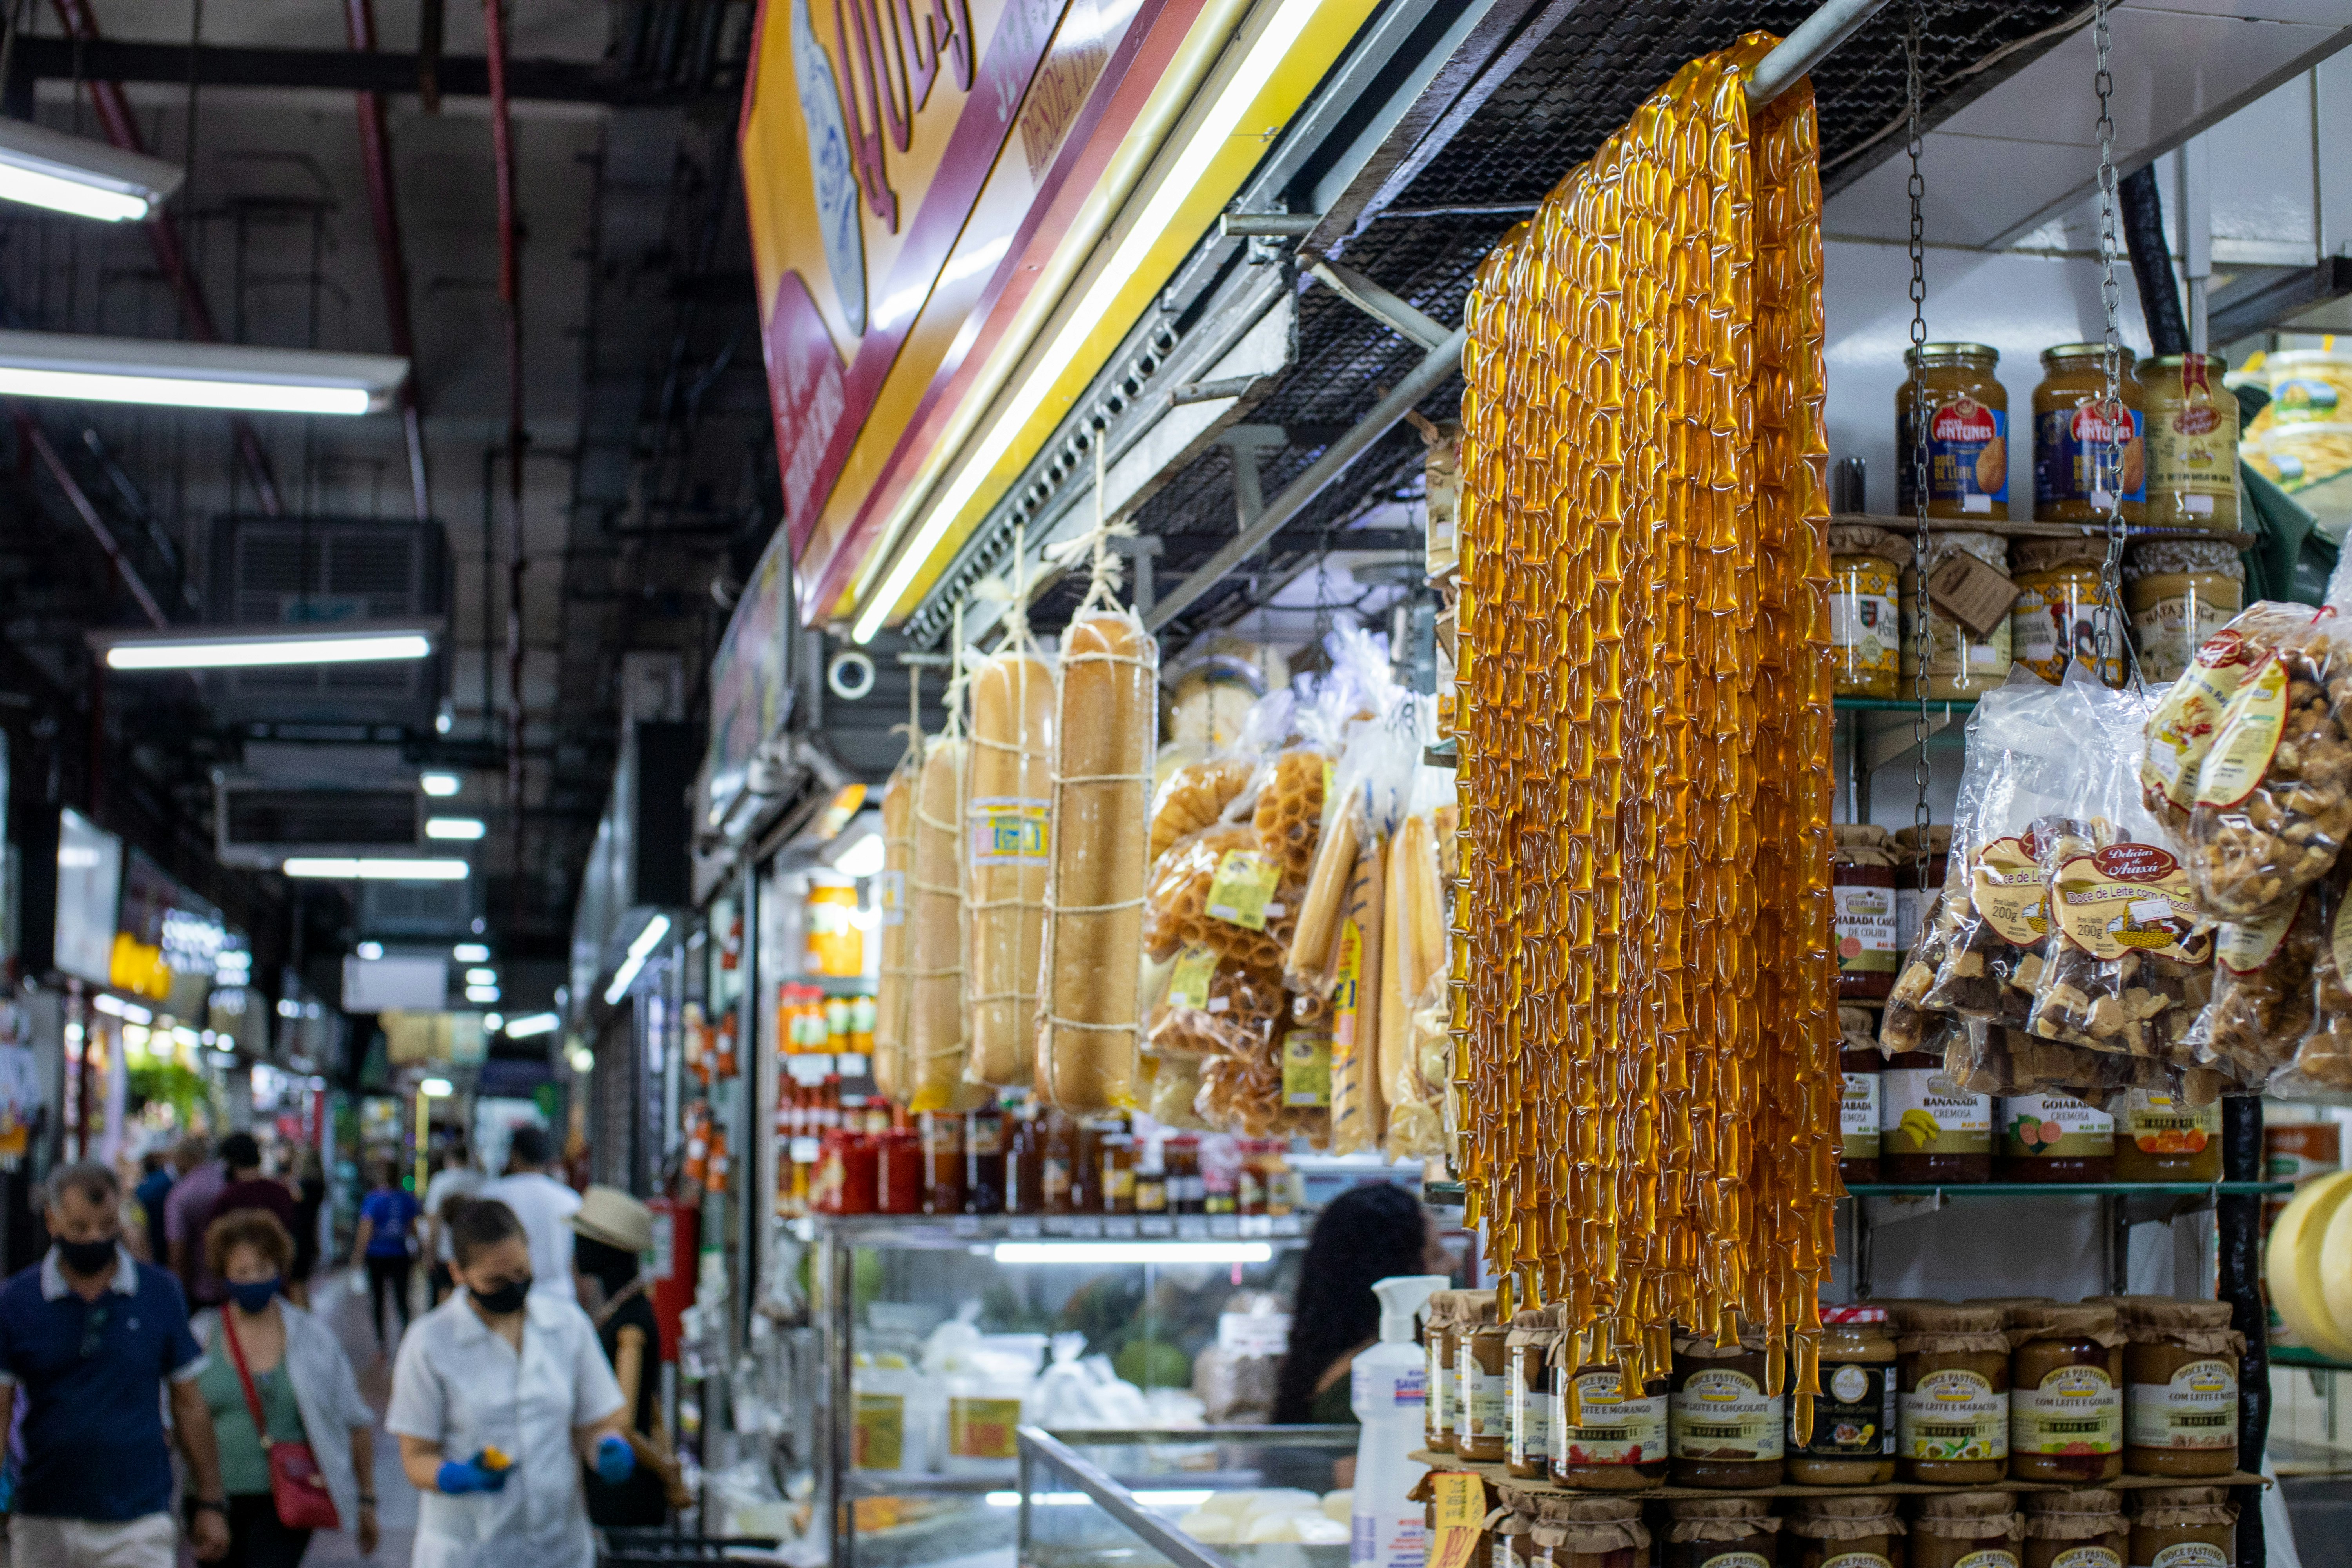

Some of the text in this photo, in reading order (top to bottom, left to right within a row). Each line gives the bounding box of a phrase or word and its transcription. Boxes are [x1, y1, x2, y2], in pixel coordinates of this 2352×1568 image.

[1937, 425, 1992, 440] ANTUNES
[2076, 425, 2131, 440] ANTUES
[2108, 848, 2153, 859] Delícias
[1989, 873, 2014, 884] Dce
[2017, 870, 2029, 883] de
[2108, 862, 2160, 877] Araxá
[2066, 891, 2094, 904] Doce
[2096, 888, 2109, 899] de
[2109, 885, 2134, 898] Leite
[2136, 889, 2158, 899] com
[1993, 906, 2018, 923] 200g
[1848, 927, 1859, 936] DE
[2078, 924, 2103, 939] 200g
[1923, 1098, 1978, 1106] BANANADA
[1933, 1109, 1971, 1118] CREMOSA
[2051, 1111, 2089, 1121] CREMOSA
[1712, 1373, 1753, 1389] PASTOSO
[1948, 1374, 1986, 1389] PASTOSO
[2073, 1369, 2108, 1384] PASTOSO
[1609, 1405, 1651, 1414] MORANGO
[1689, 1403, 1710, 1411] LEITE
[1720, 1403, 1768, 1412] CHOCOLATE
[1926, 1402, 1949, 1411] LEITE
[2035, 1398, 2054, 1406] COM
[2056, 1398, 2080, 1406] LEITE
[2082, 1398, 2088, 1406] E
[2058, 1550, 2118, 1566] DOCE PASTOSO
[2161, 1546, 2223, 1563] DOCE PASTOSO
